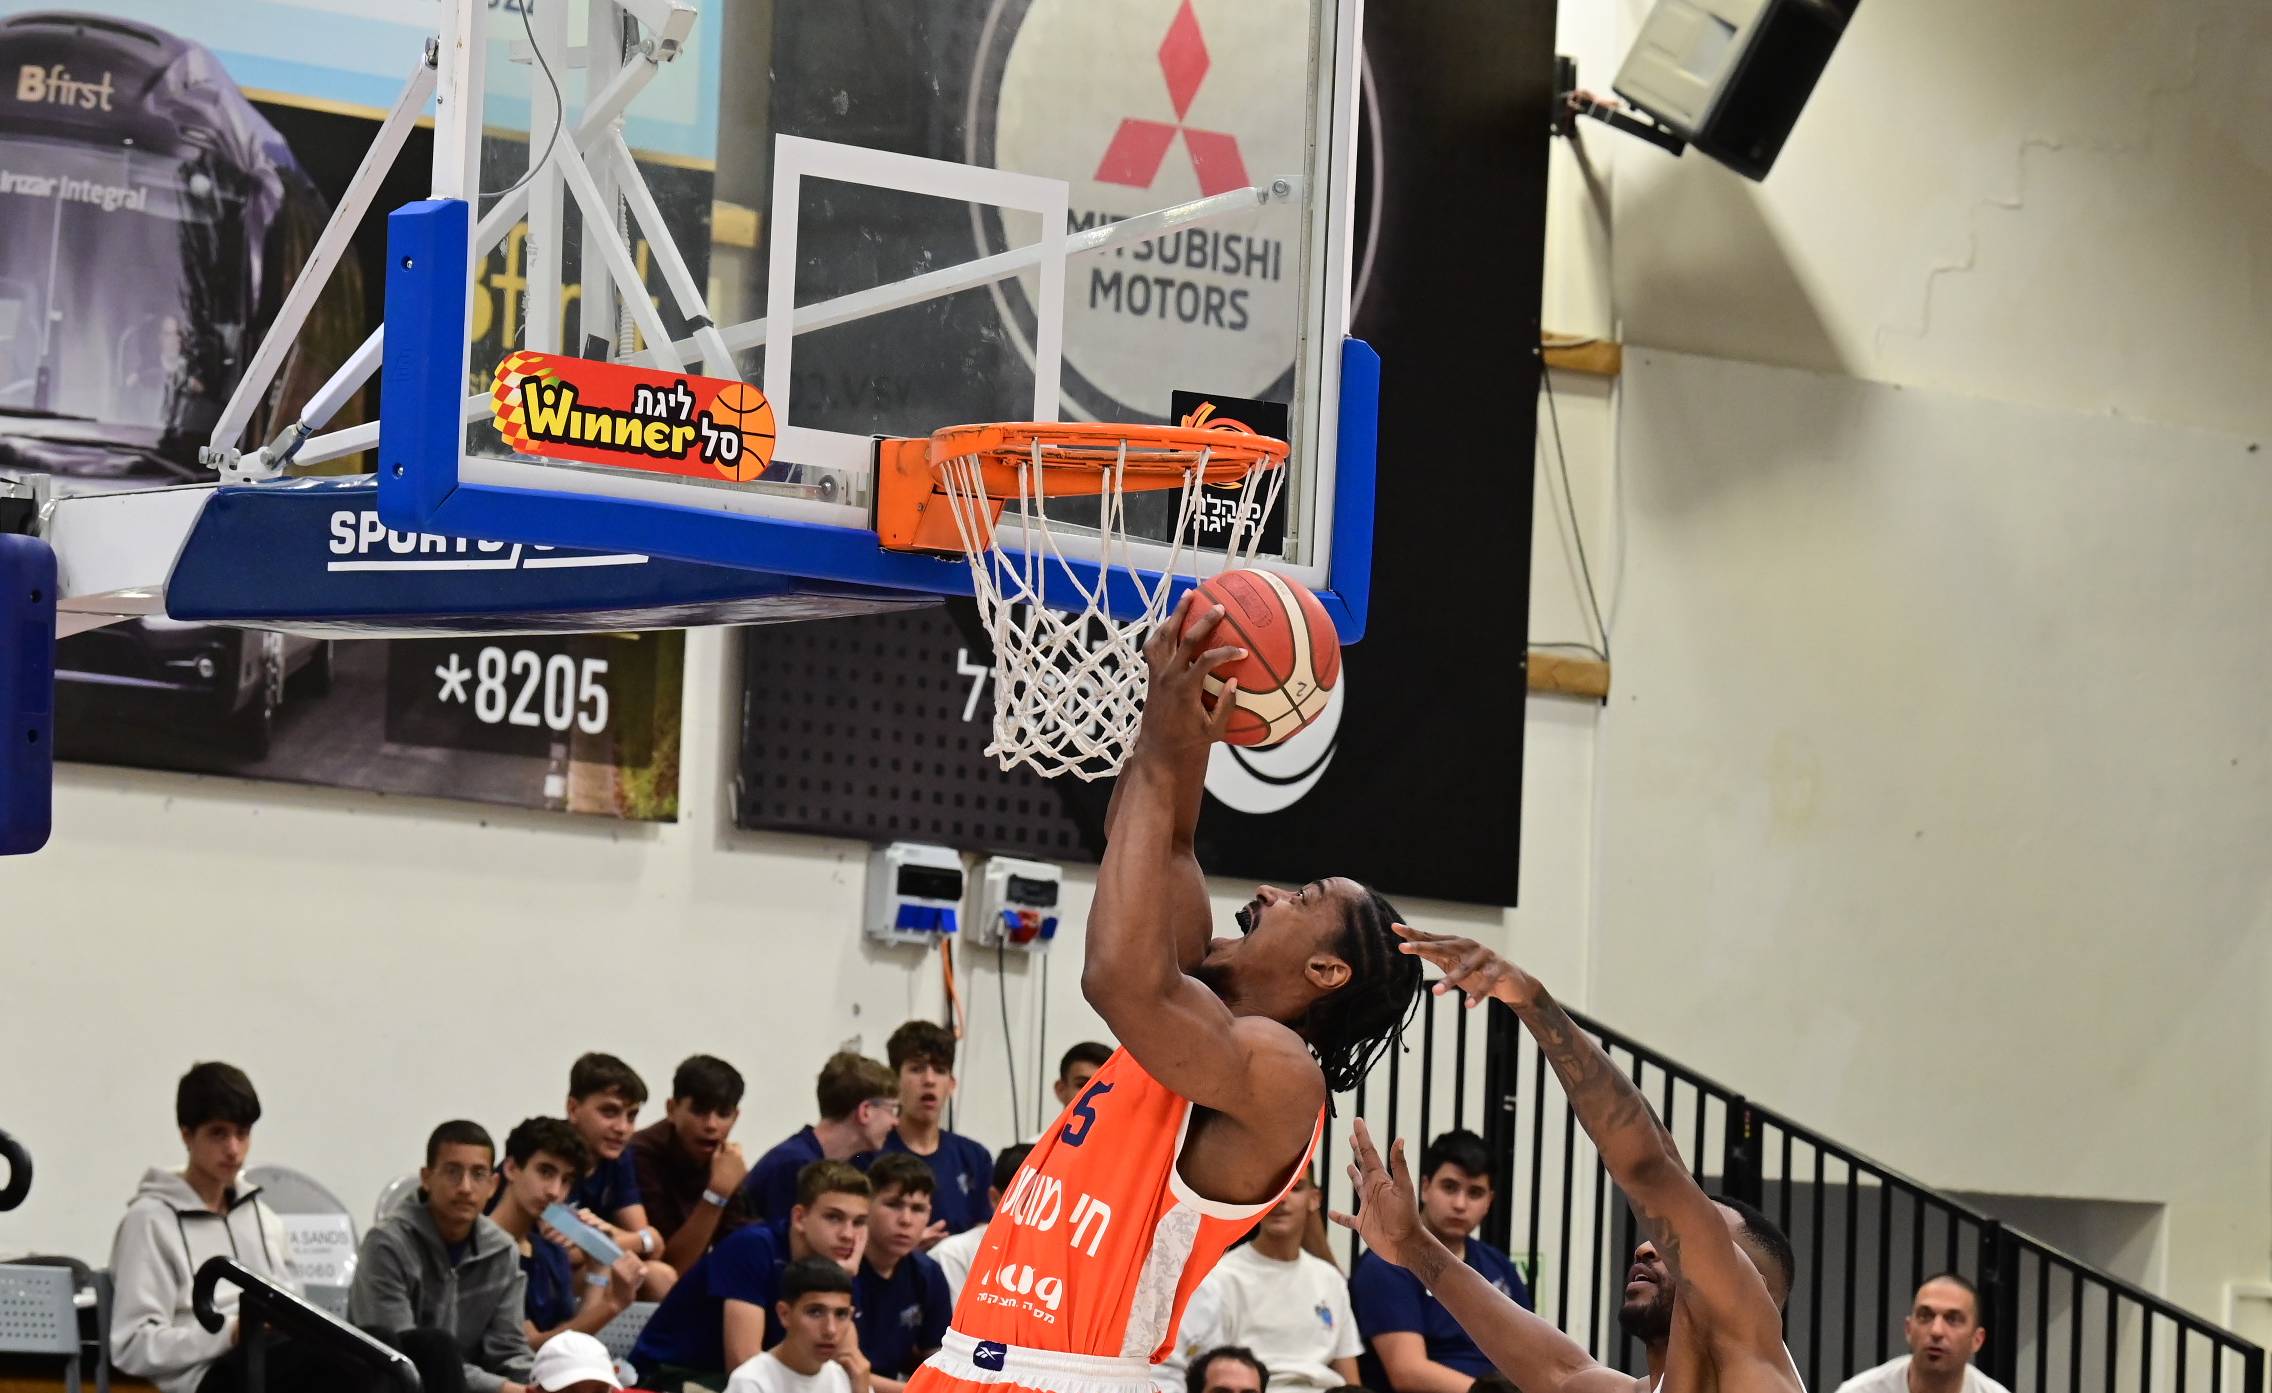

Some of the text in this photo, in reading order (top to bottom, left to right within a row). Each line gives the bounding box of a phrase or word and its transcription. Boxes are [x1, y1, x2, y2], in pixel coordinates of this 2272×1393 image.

[16, 64, 115, 112] Bfirst
[59, 175, 148, 212] Integral
[1067, 208, 1281, 281] MUBISHI
[1089, 268, 1249, 331] MOTORS
[634, 385, 692, 420] ליגת
[702, 417, 739, 460] סל
[1061, 1080, 1114, 1147] 5
